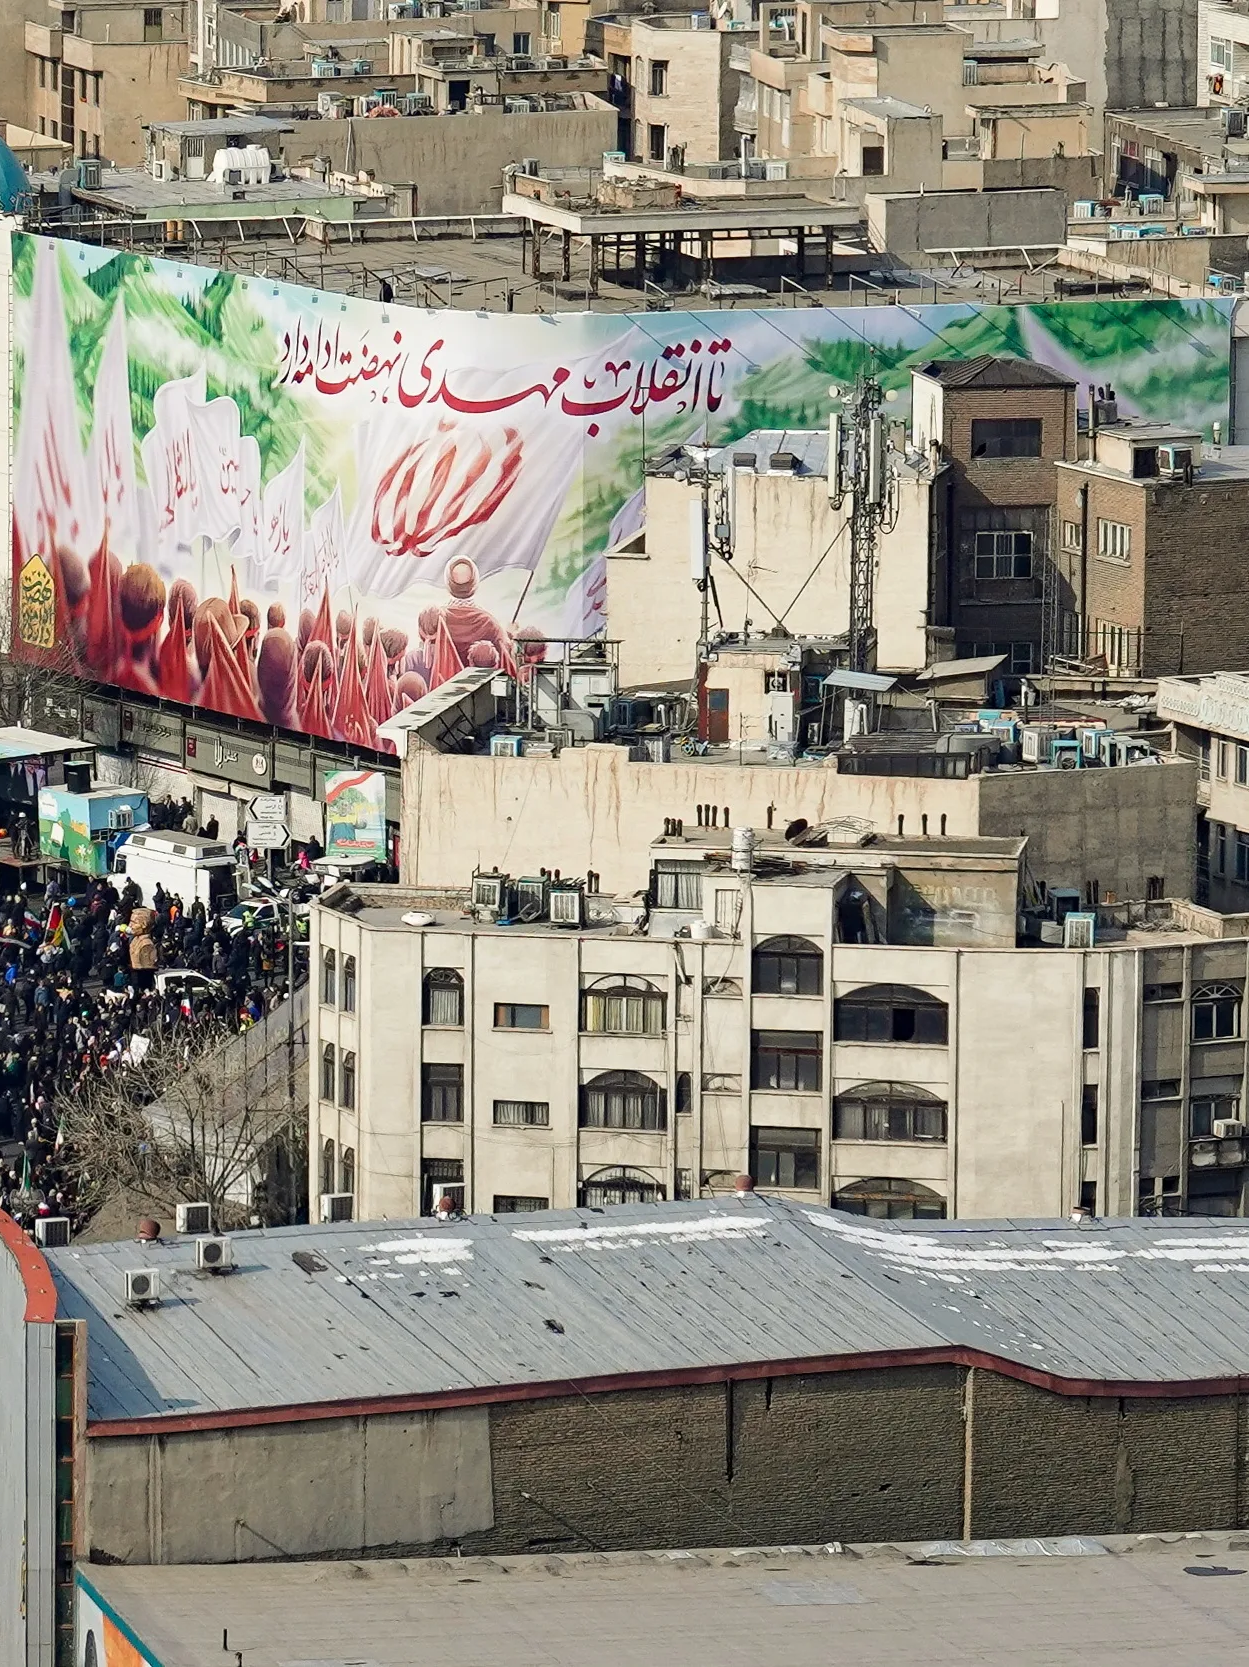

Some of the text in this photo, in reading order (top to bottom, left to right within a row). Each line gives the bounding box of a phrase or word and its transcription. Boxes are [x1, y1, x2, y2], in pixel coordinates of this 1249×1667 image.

[279, 314, 732, 438] تا انقلاب مهدی نهضت ادامه دارد
